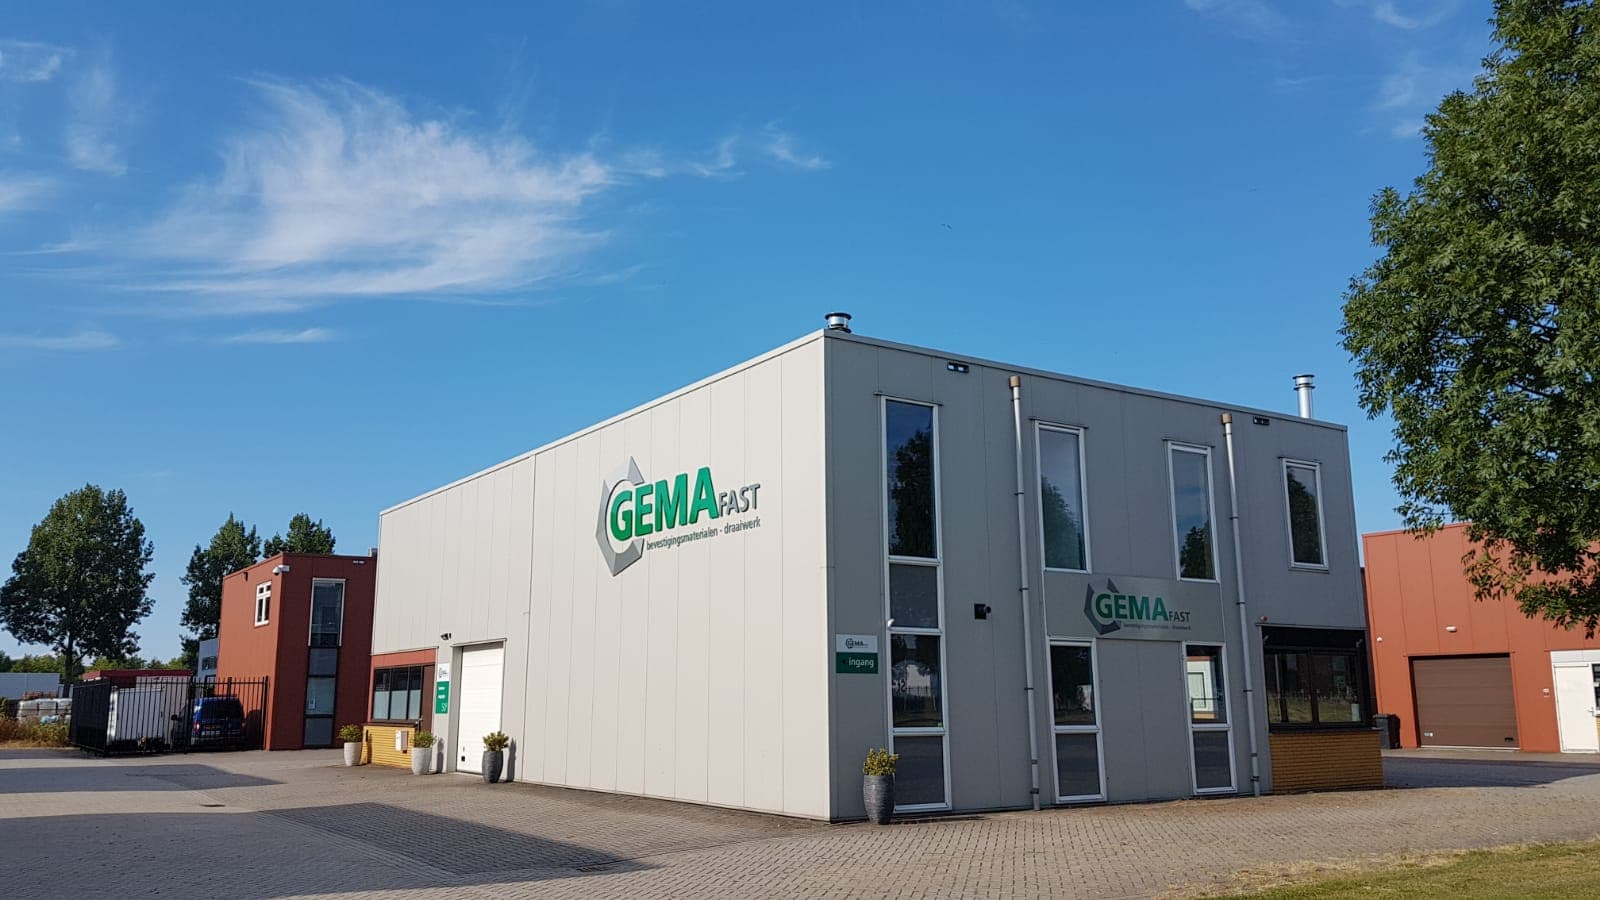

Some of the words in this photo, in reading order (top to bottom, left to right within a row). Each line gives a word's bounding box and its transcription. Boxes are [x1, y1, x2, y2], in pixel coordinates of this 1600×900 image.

[610, 466, 719, 541] GEMA
[719, 484, 760, 517] FAST
[646, 526, 718, 550] bevestigingsmaterialen
[724, 516, 761, 534] draaiwerk
[1095, 593, 1168, 621] GEMA
[1168, 611, 1190, 622] FAST
